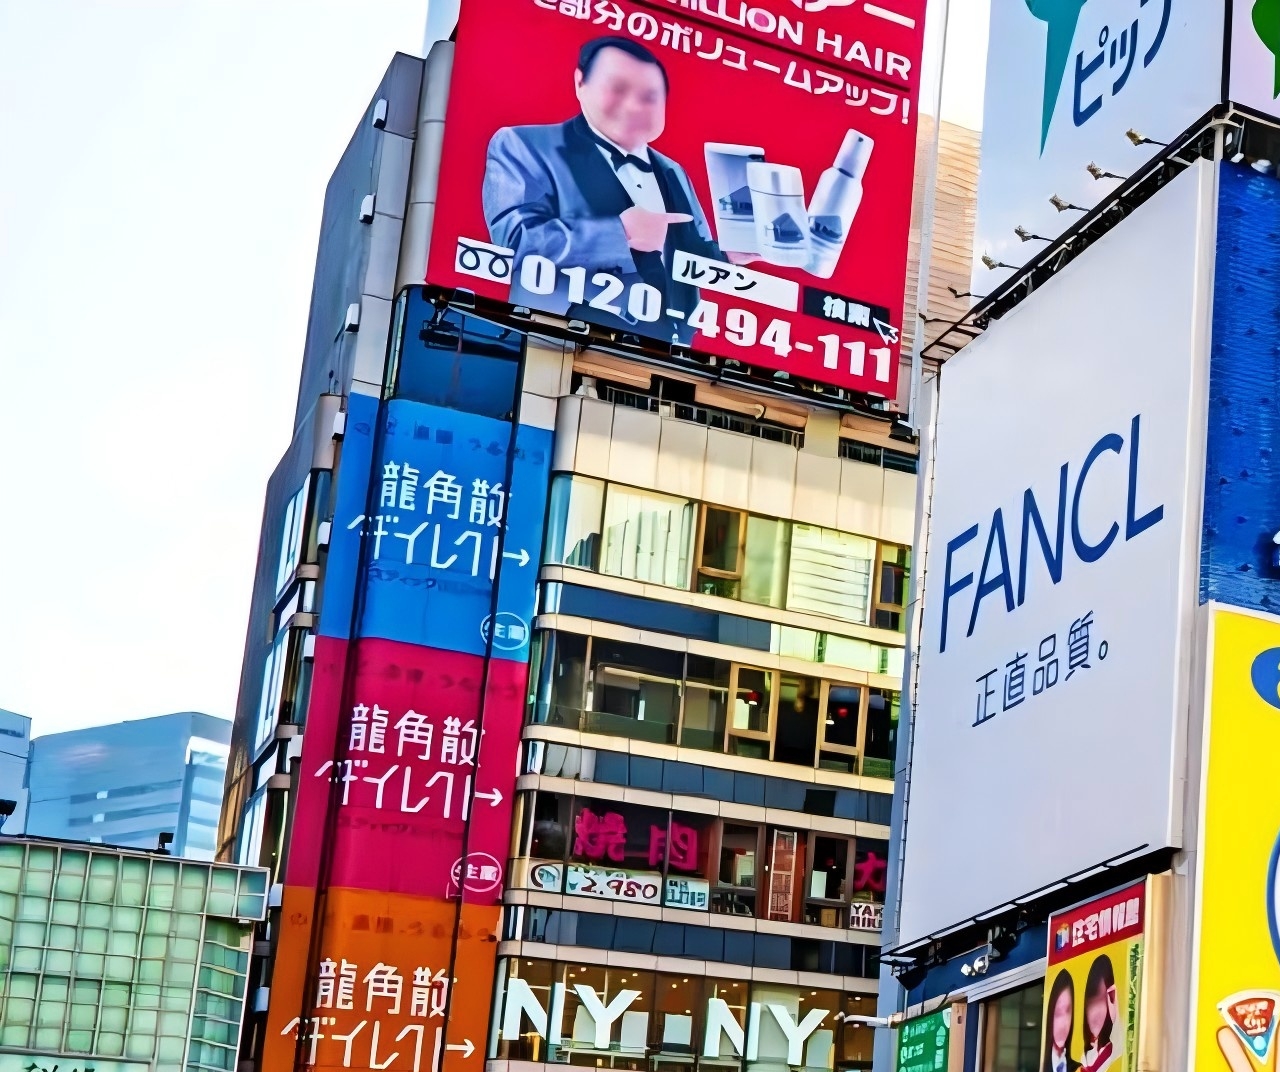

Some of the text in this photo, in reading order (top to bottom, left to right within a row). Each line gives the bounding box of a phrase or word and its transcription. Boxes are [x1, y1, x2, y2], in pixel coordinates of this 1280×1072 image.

[815, 28, 913, 81] HAIR
[681, 260, 757, 291] ルアン
[520, 254, 890, 382] 0120-494-111
[380, 460, 513, 528] 龍角散
[940, 414, 1164, 653] FANCL
[972, 610, 1108, 727] 正直品質。
[349, 703, 486, 767] 龍角散
[316, 954, 457, 1018] 龍角散
